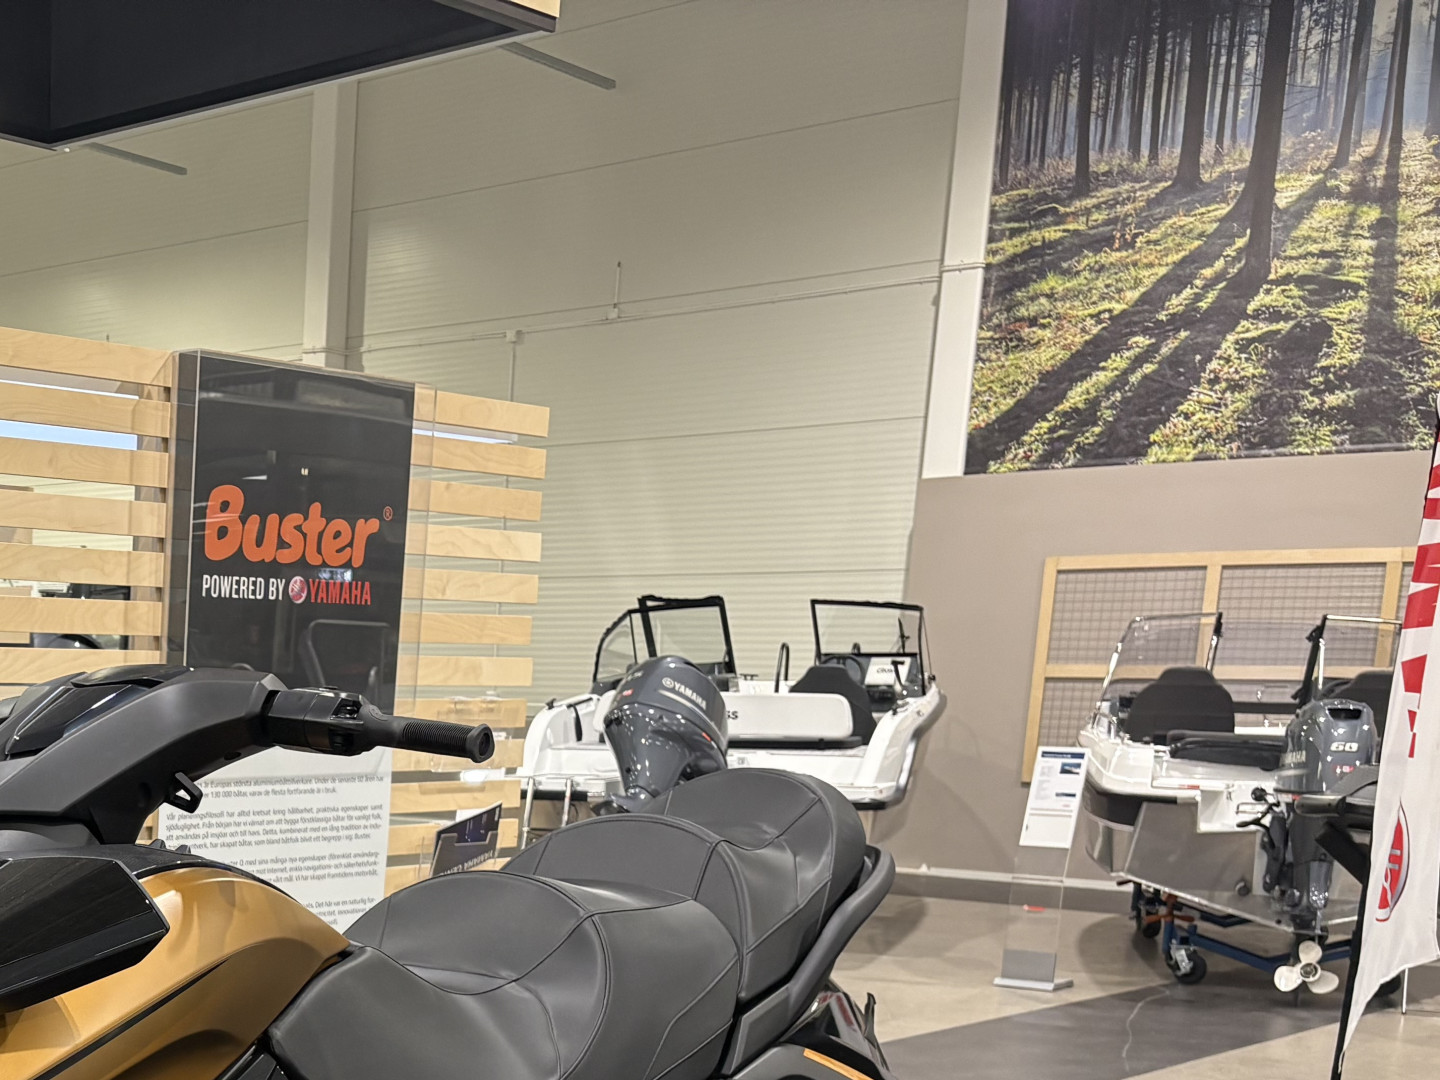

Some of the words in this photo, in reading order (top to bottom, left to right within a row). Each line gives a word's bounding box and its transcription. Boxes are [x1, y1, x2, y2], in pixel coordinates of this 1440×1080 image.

[205, 484, 380, 568] Buster
[202, 574, 265, 599] POWERED
[268, 578, 286, 601] BY
[309, 578, 371, 606] YAMAHA
[674, 681, 707, 710] YAMAHA
